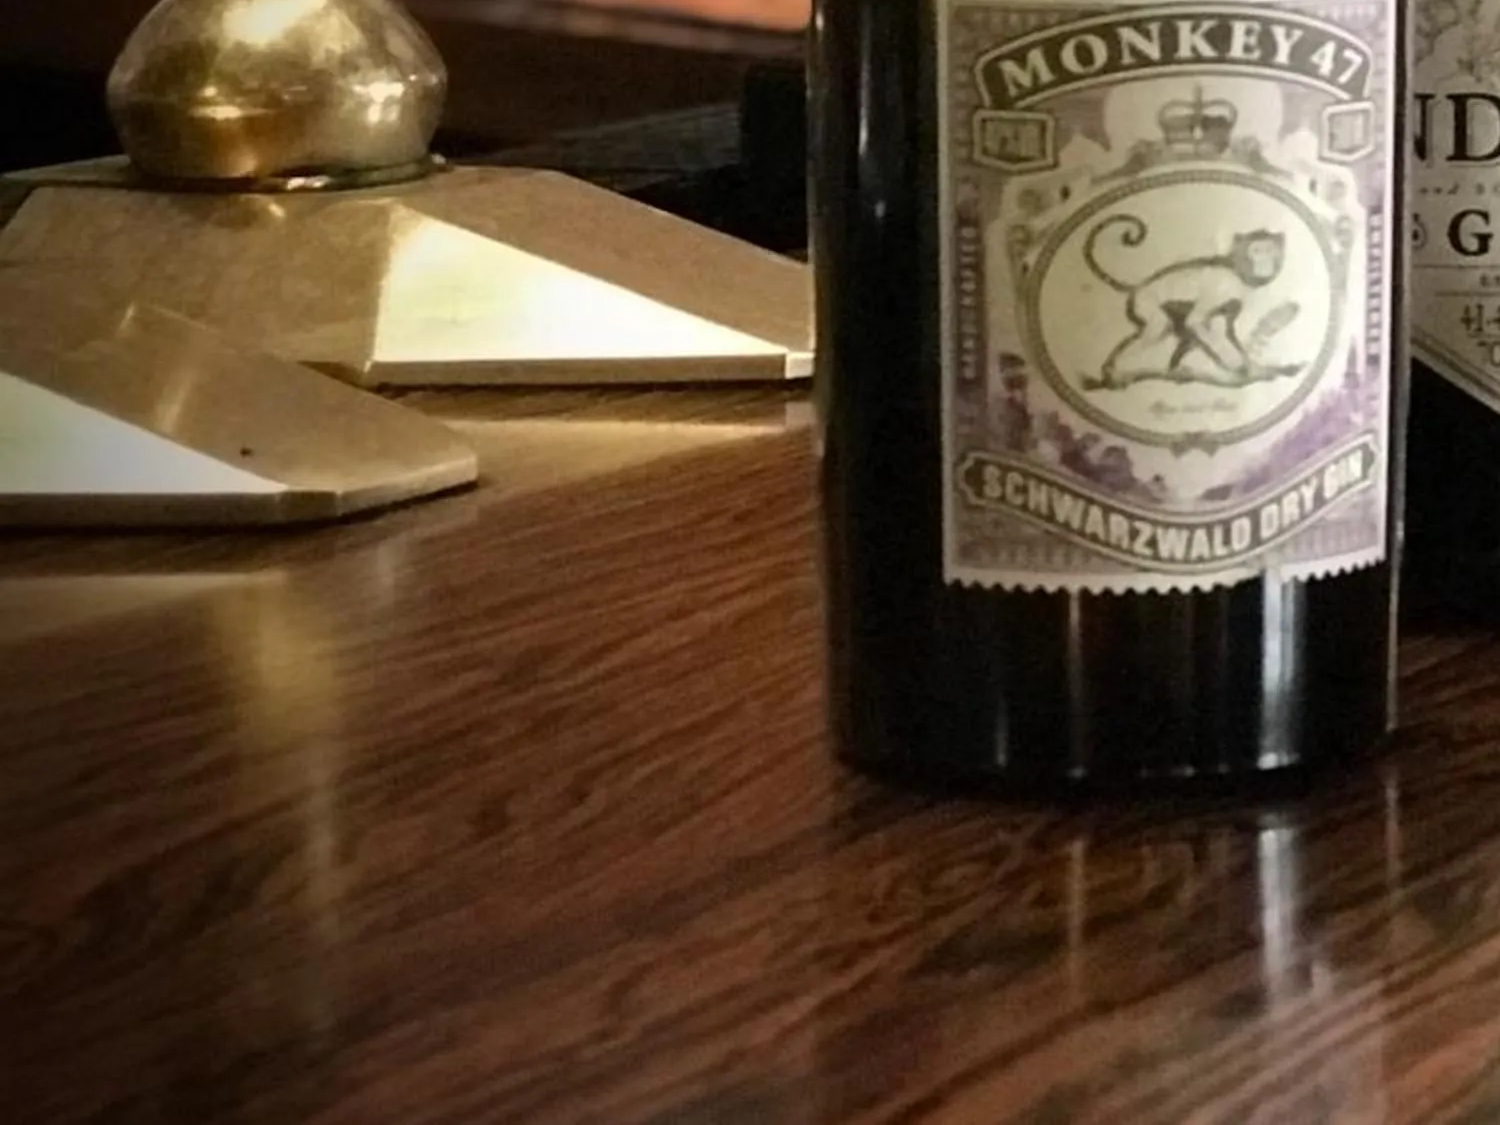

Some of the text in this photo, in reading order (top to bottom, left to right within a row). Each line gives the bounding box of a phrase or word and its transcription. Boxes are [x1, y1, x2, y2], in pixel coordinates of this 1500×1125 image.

[1001, 19, 1365, 98] MONKEY 47
[982, 464, 1252, 561] SCHWARZWALD
[1260, 479, 1321, 538] DRY
